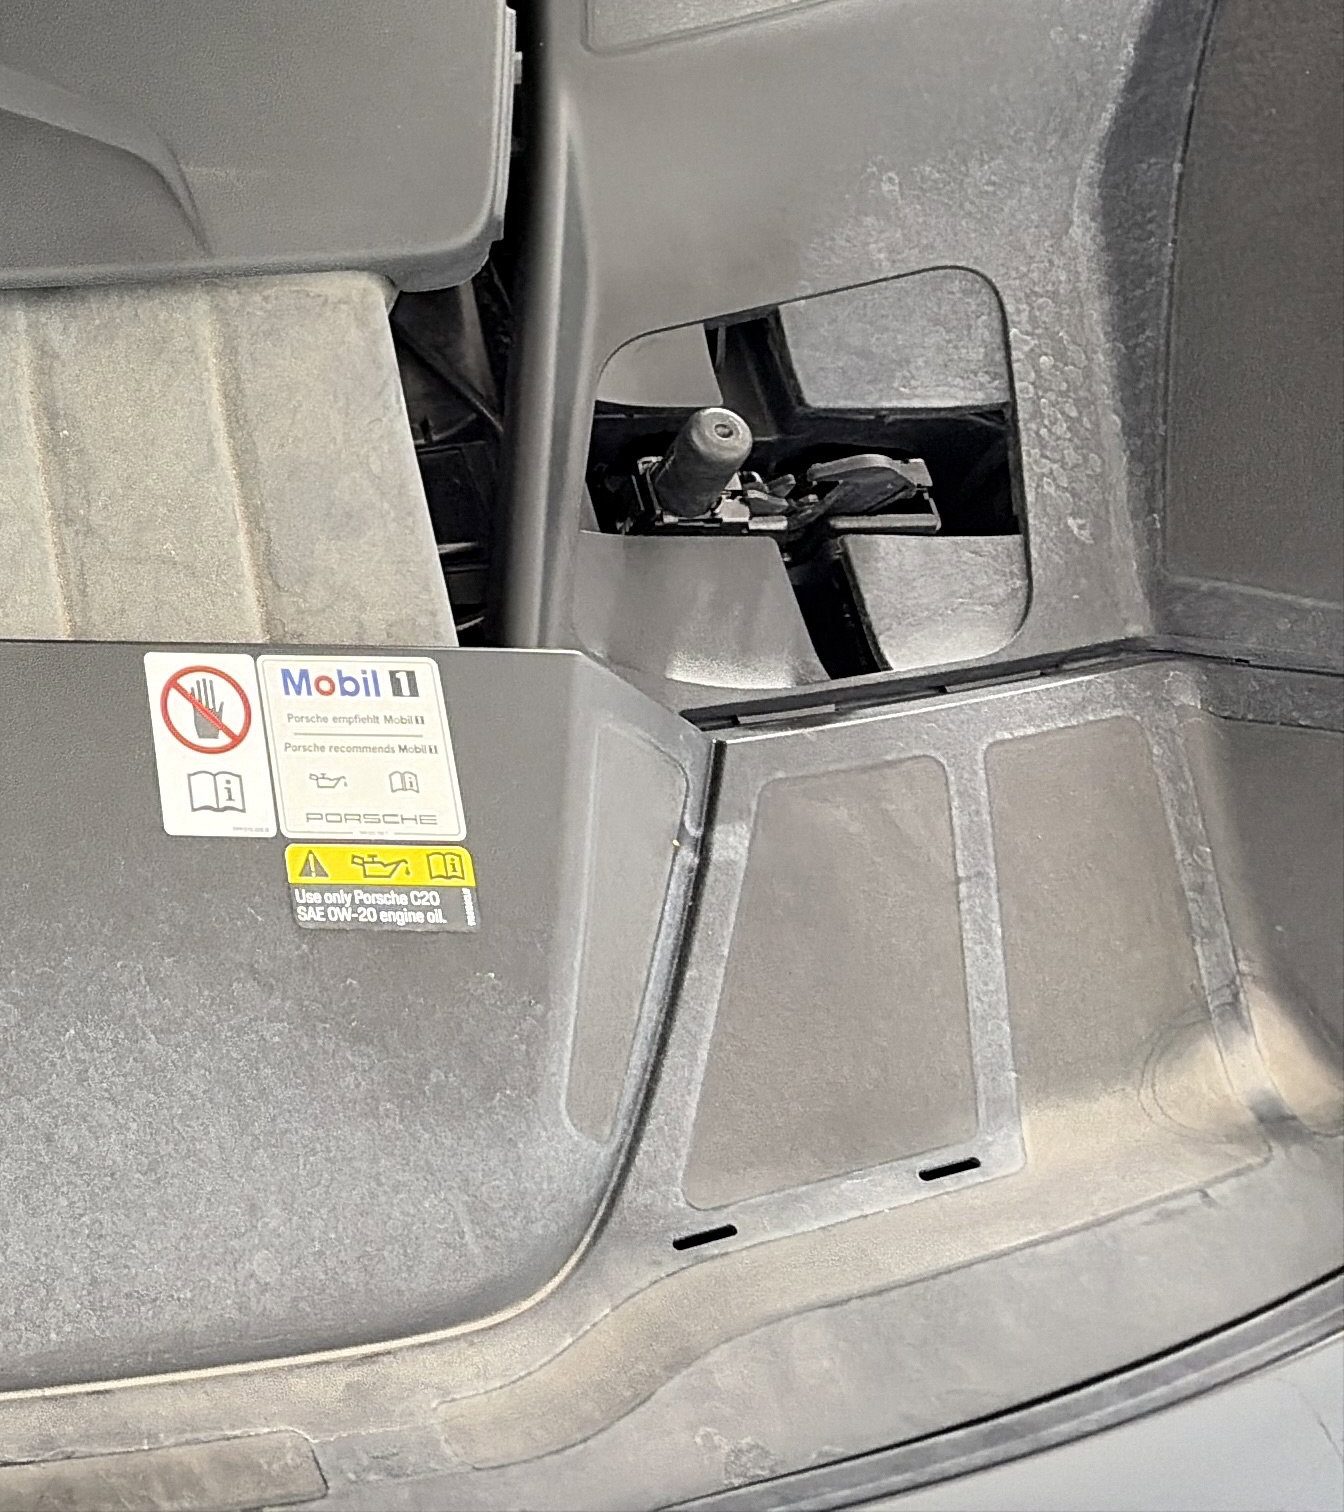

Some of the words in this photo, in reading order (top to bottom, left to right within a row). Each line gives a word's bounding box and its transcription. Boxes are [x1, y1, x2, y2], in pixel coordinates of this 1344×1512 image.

[280, 668, 381, 697] Mobil
[391, 670, 417, 697] 1
[287, 713, 329, 724] Porsche
[332, 714, 380, 725] empfiehlt
[383, 715, 413, 724] Mobil
[284, 742, 326, 753] Porsche
[328, 744, 395, 753] recommends
[398, 744, 427, 754] Mobil
[305, 812, 439, 825] PORSCHE
[295, 889, 322, 904] Use
[324, 890, 352, 907] only
[354, 890, 408, 905] Porsche
[410, 891, 440, 906] C20
[297, 906, 326, 922] SAE
[379, 908, 425, 926] engine
[427, 909, 448, 924] oil.
